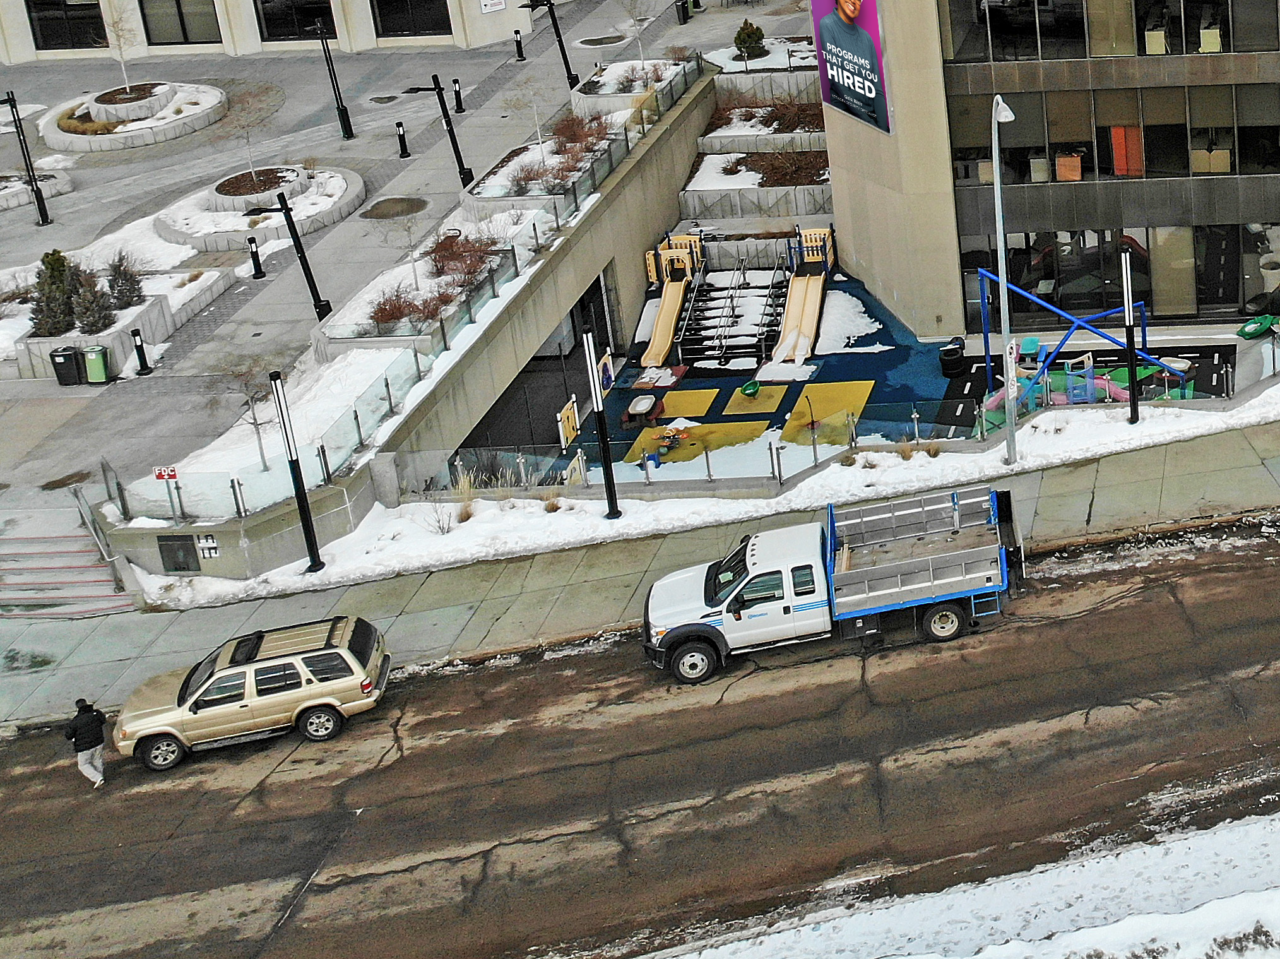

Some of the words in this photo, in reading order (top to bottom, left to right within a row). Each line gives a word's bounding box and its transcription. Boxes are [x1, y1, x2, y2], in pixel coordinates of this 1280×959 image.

[821, 50, 842, 67] THAT
[843, 60, 859, 74] GET
[860, 68, 878, 83] YOU
[826, 42, 871, 69] PROGRAMS
[826, 62, 876, 99] HIRED
